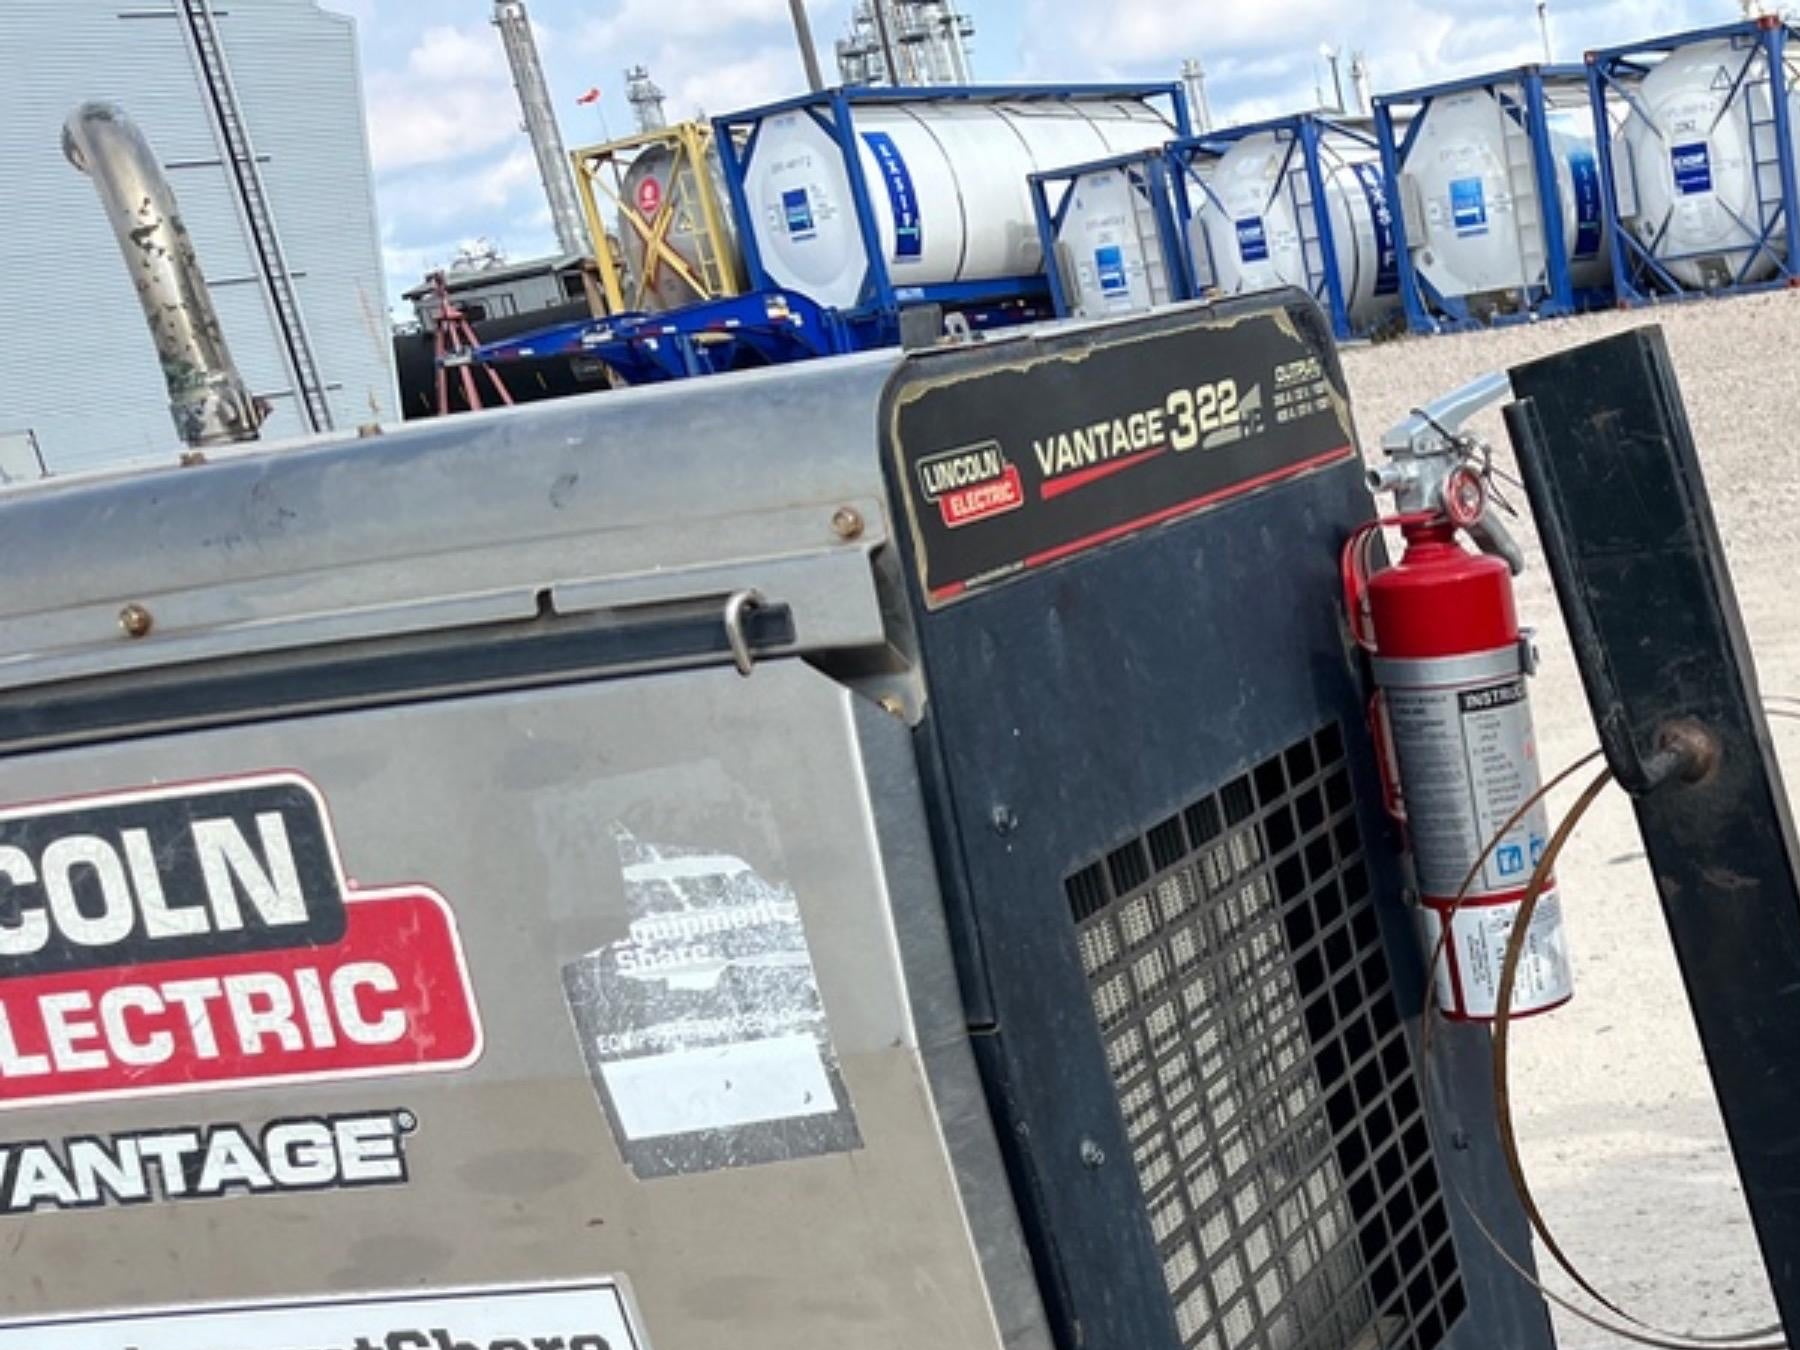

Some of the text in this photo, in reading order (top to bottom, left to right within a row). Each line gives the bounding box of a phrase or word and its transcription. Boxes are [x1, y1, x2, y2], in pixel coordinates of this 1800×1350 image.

[1034, 379, 1241, 476] VANTAGE 322
[923, 449, 1000, 493] LINCOLN
[950, 480, 1016, 518] ELECTRIC
[0, 1115, 403, 1208] ANTAGE
